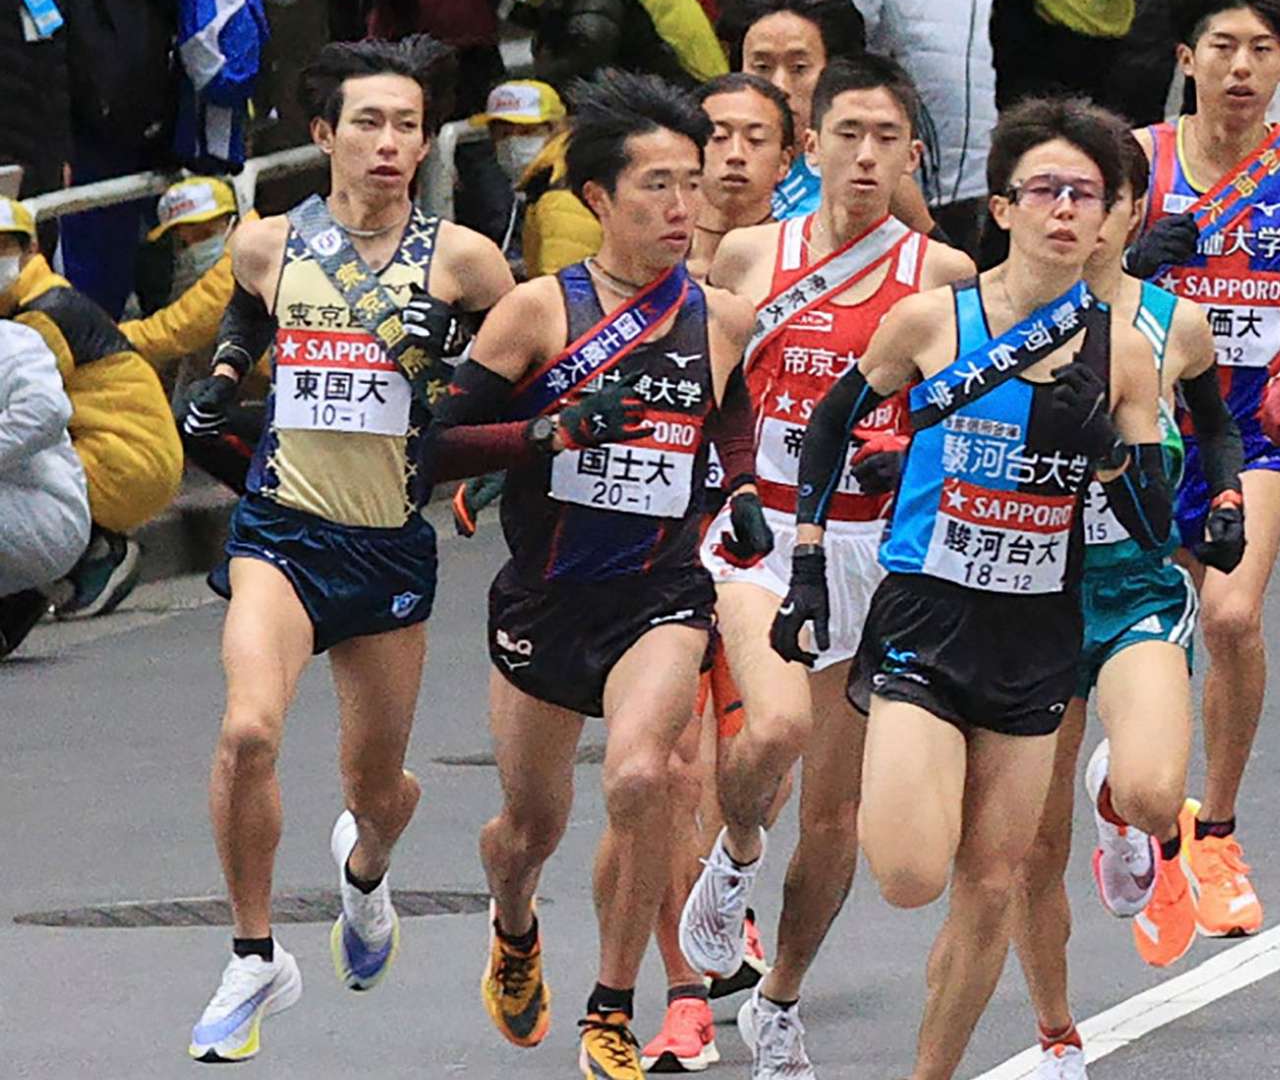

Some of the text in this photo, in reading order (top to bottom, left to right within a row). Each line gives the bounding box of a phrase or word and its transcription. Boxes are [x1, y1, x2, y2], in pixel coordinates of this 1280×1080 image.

[926, 302, 1079, 410] 駿河台大学
[293, 370, 389, 404] 東国大
[311, 404, 366, 428] 10-1
[577, 447, 675, 486] 国士大
[971, 497, 1074, 526] SAPPORO
[945, 520, 1059, 566] 駿河台大
[963, 561, 1032, 590] 18-12
